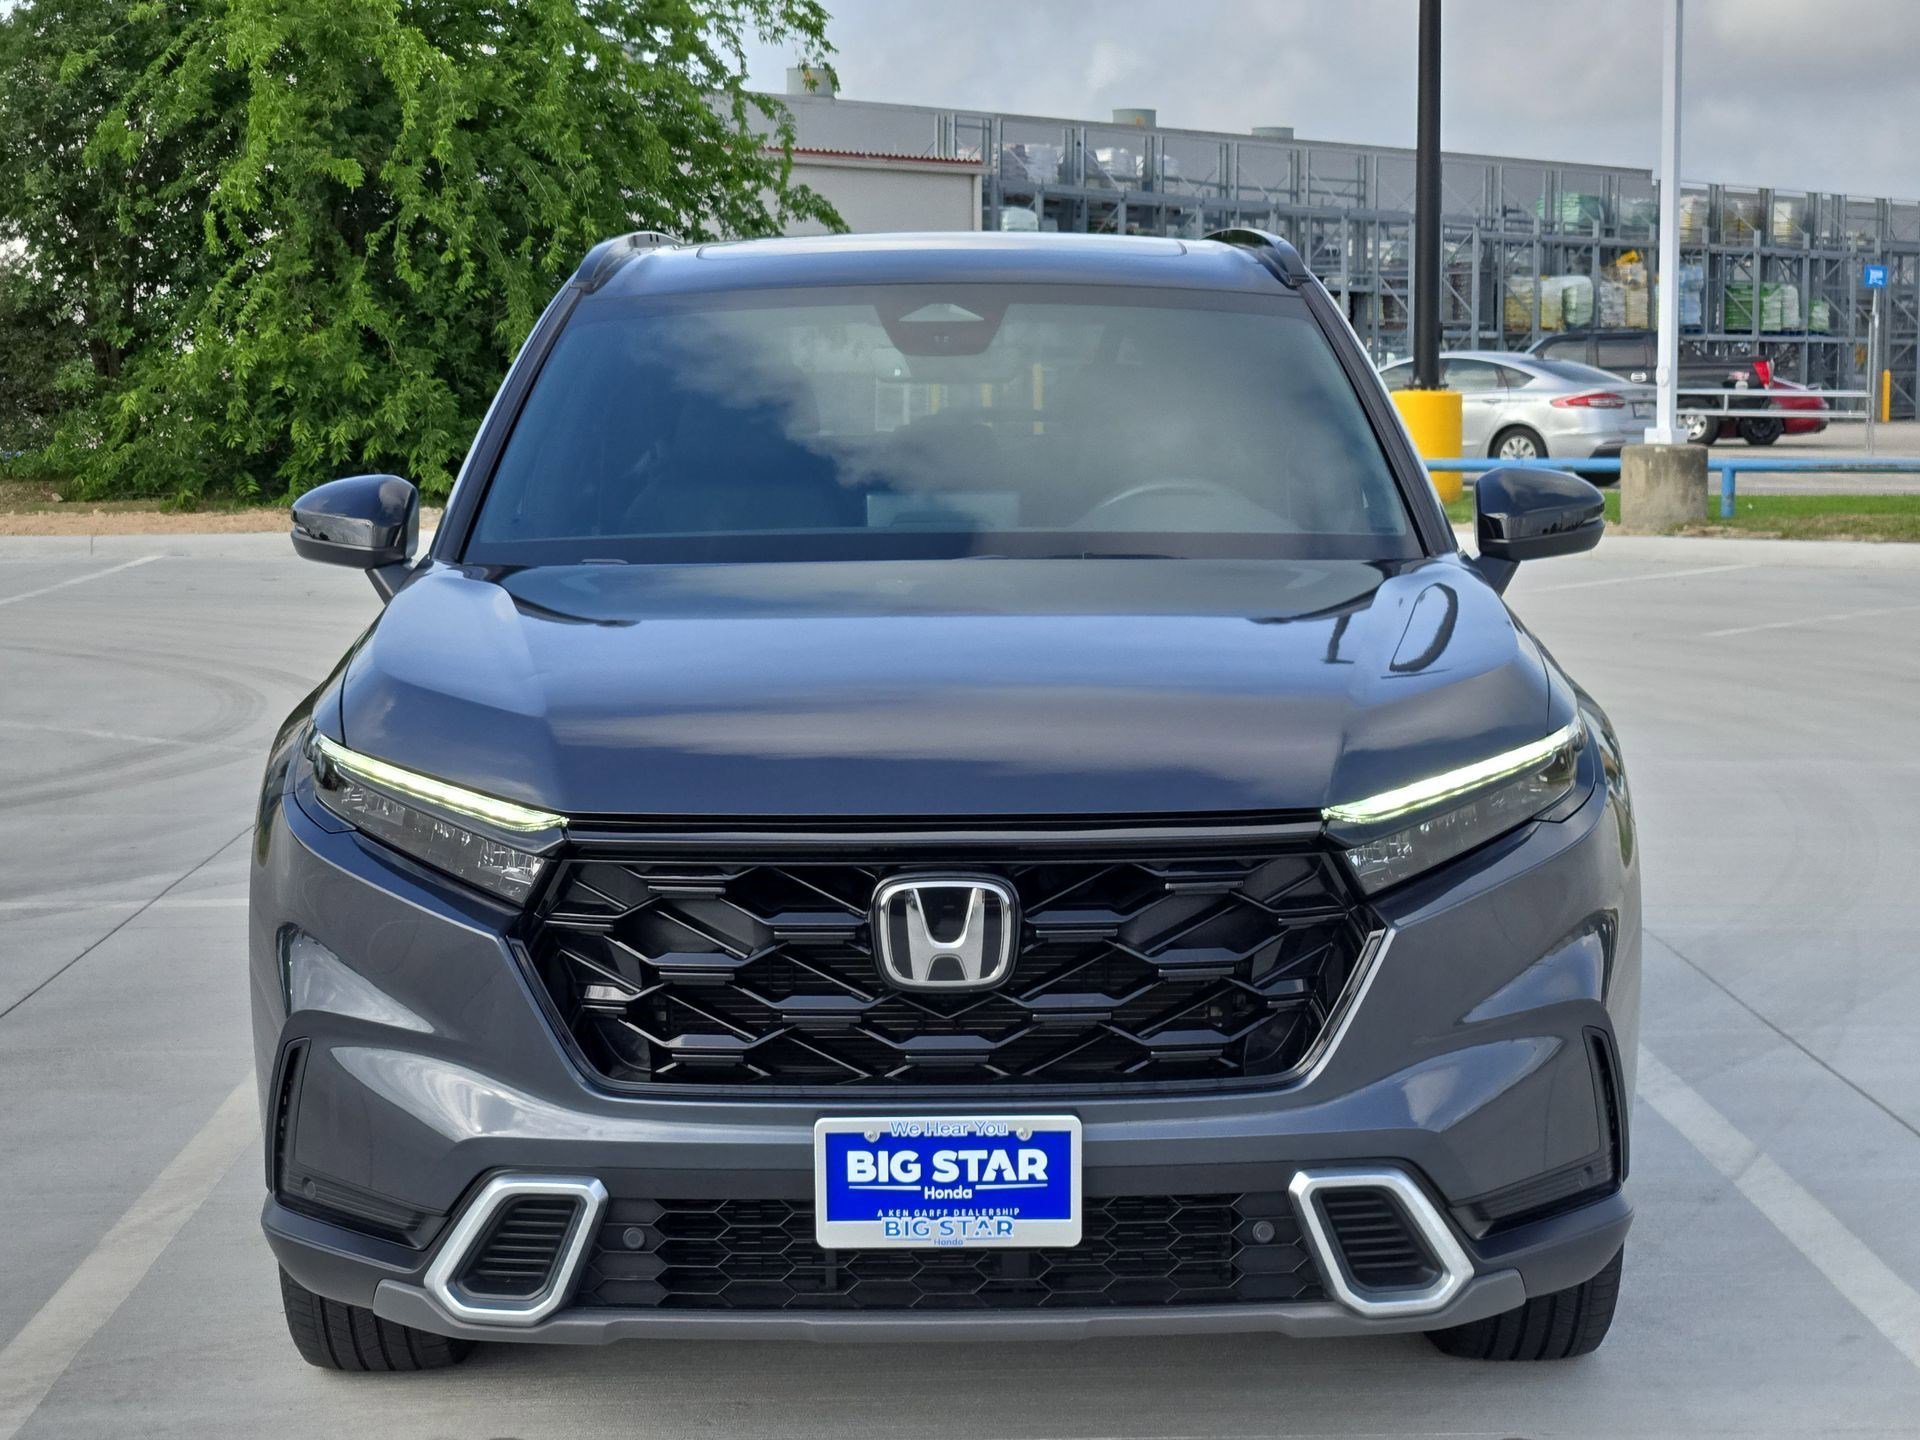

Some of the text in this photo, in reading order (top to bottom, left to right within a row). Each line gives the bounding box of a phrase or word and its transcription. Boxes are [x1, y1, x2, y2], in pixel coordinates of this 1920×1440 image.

[905, 887, 986, 981] H
[890, 1120, 1008, 1136] We Hear You
[847, 1148, 1049, 1183] BIG STAR
[924, 1185, 973, 1200] Honda
[877, 1207, 1020, 1217] A KEN GARFF DEALERSHIP
[884, 1219, 1014, 1237] BIG STAR
